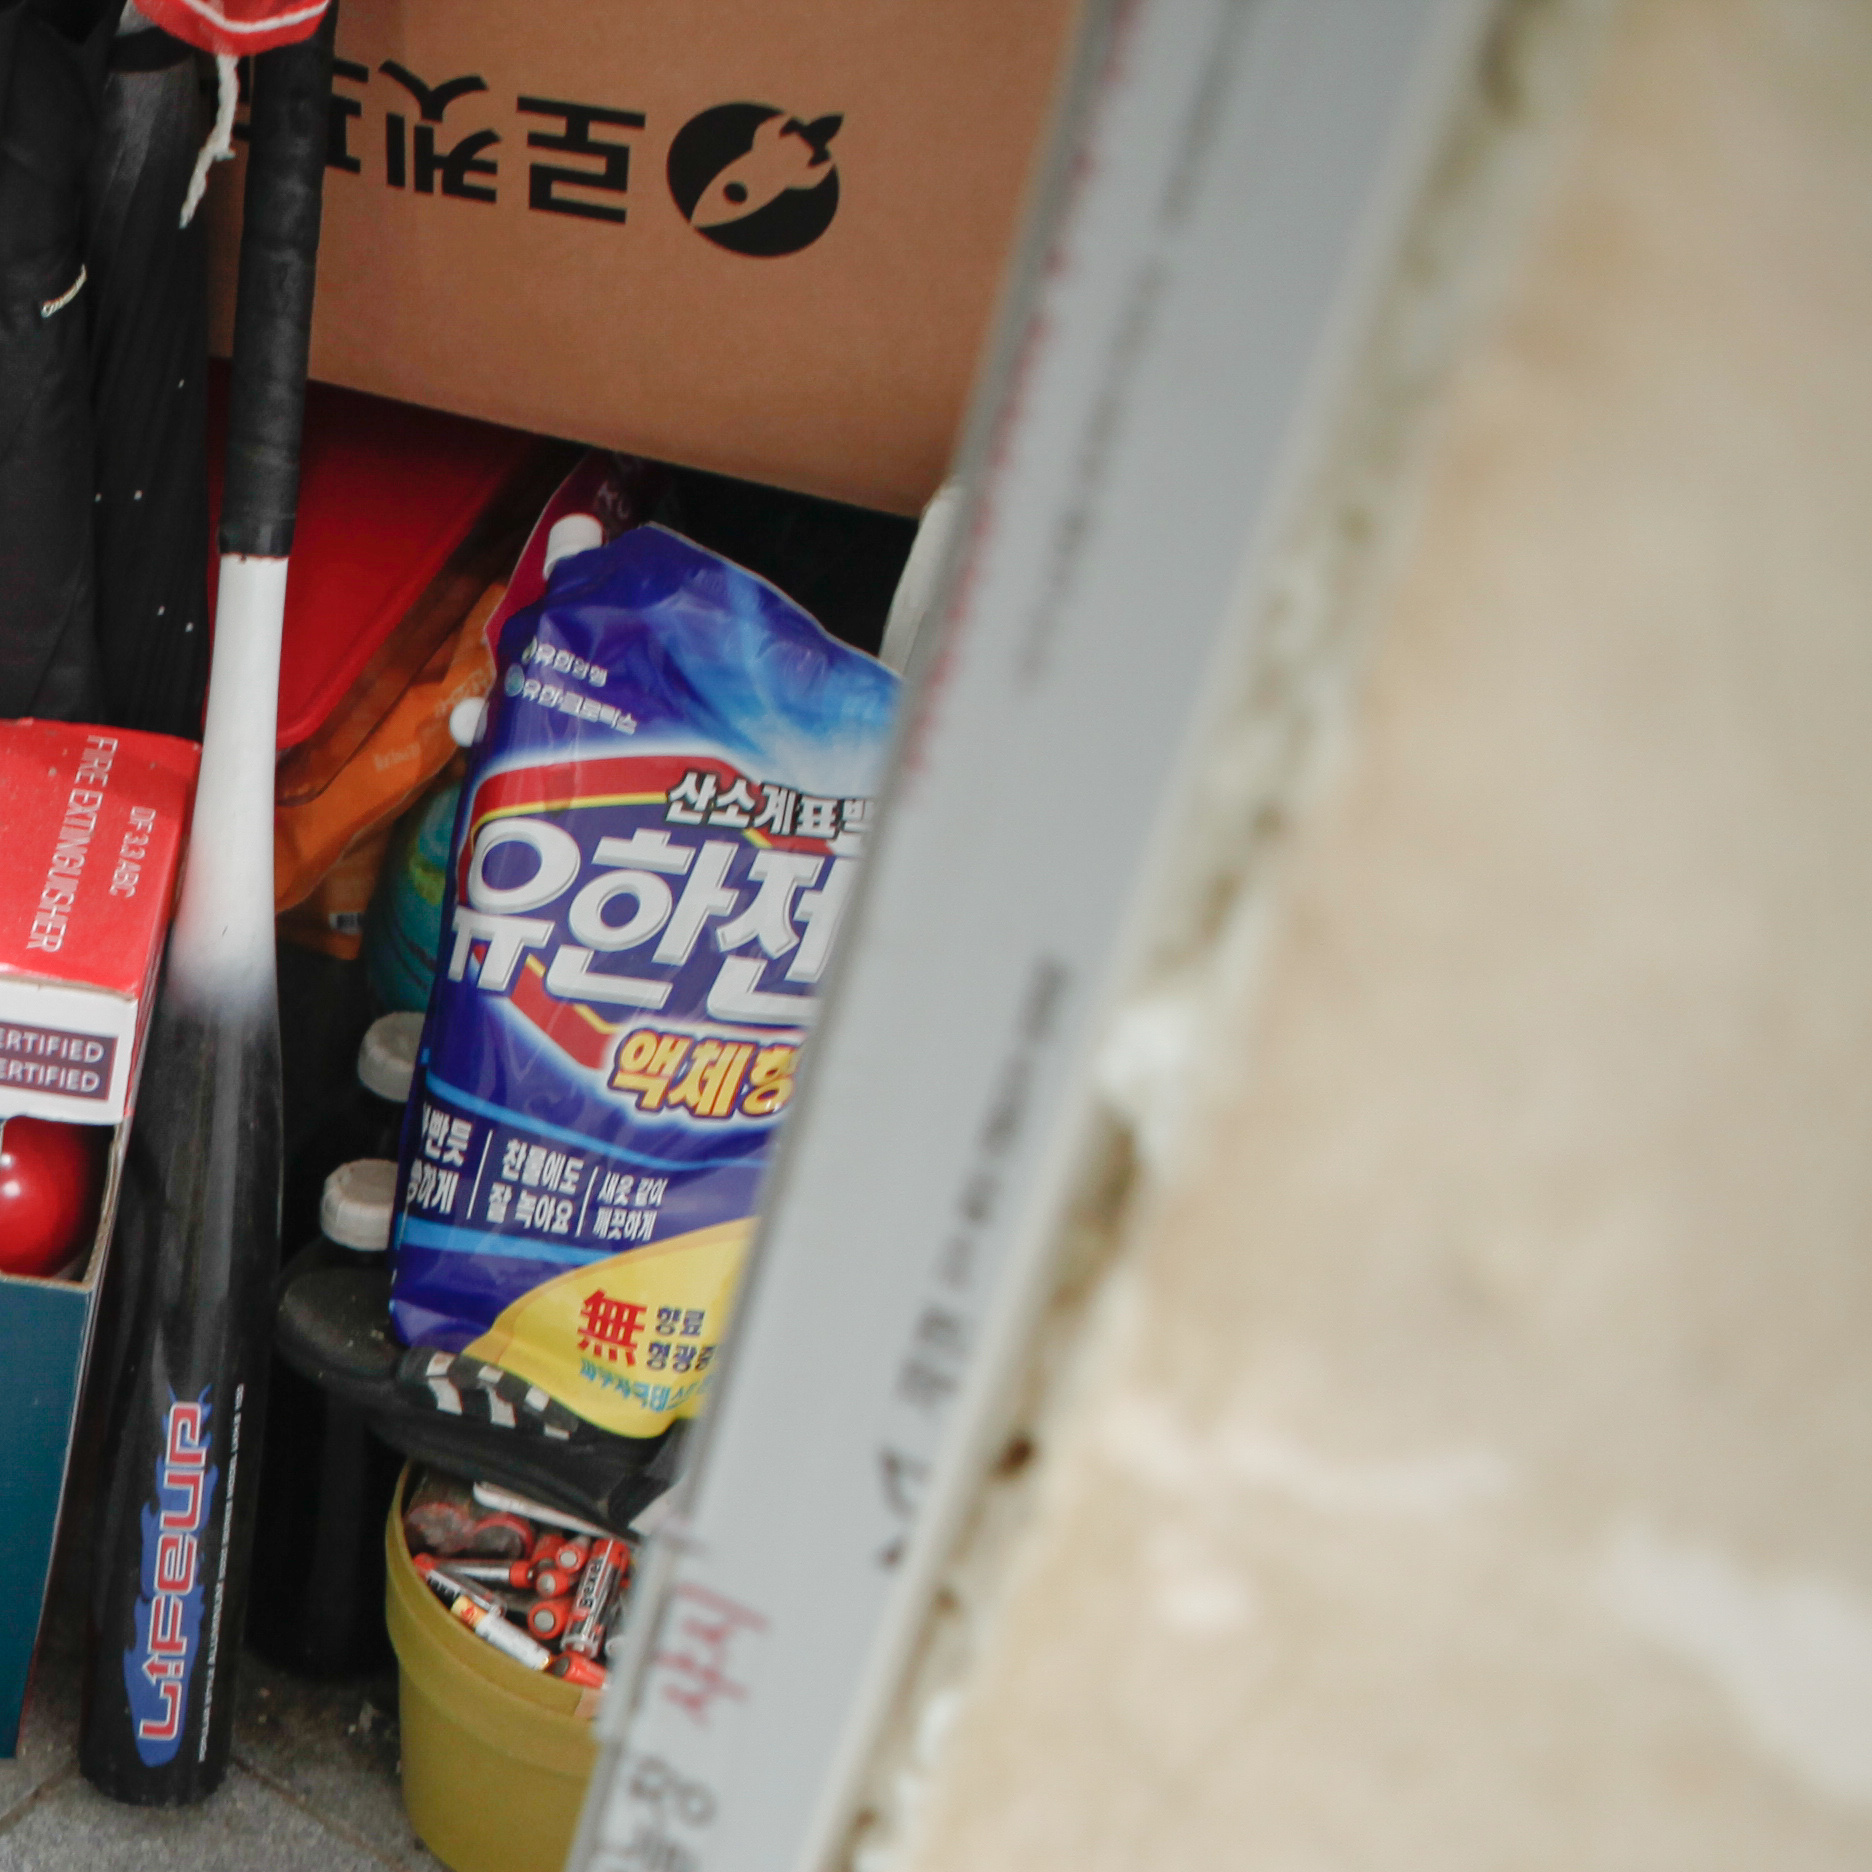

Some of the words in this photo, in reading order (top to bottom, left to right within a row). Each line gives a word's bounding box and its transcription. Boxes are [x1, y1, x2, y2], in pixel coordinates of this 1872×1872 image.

[75, 735, 118, 787] FIRE
[26, 788, 103, 953] EXTINGUISHER
[577, 1288, 648, 1367] 無
